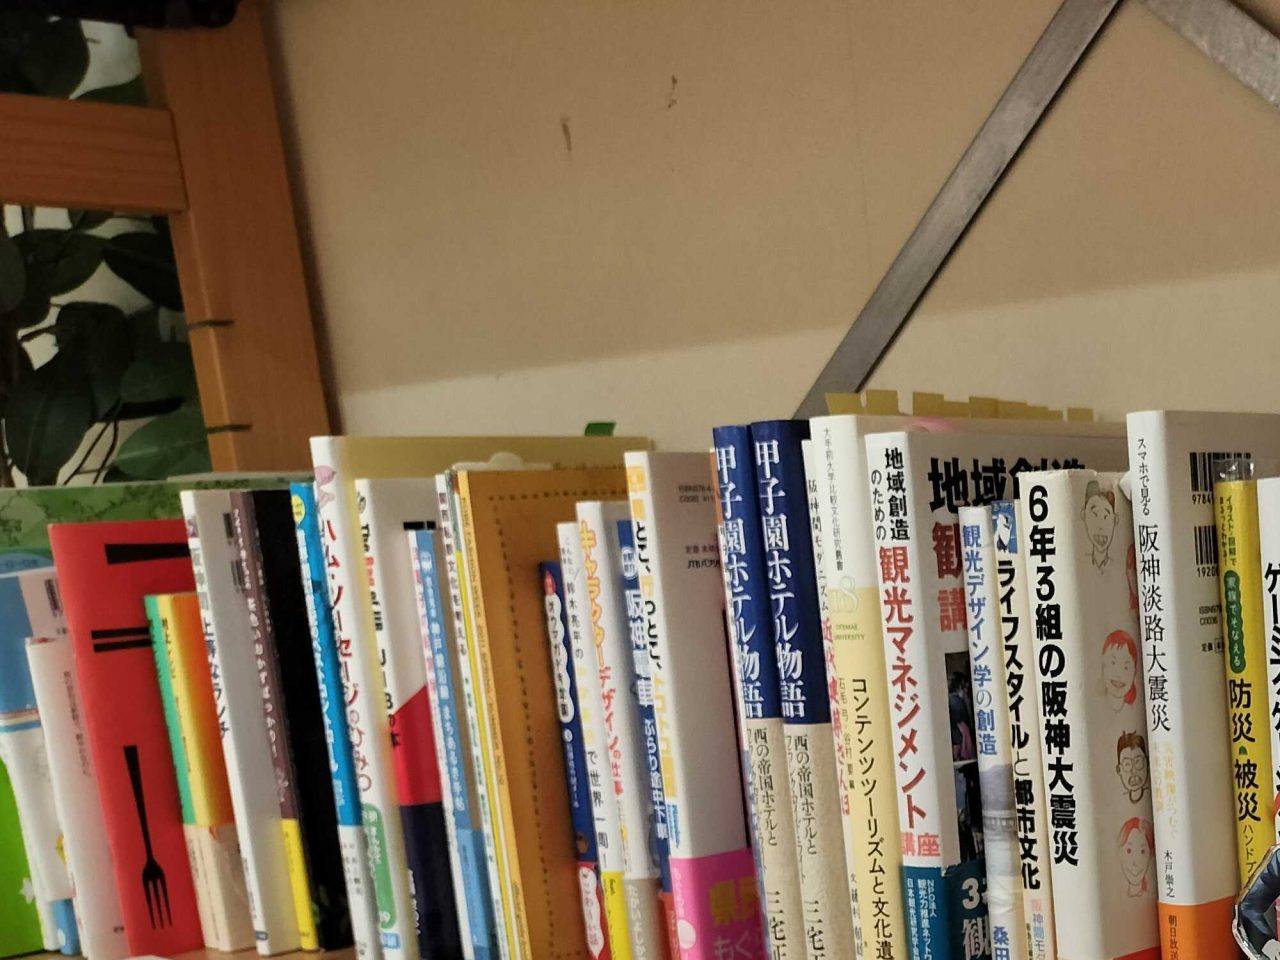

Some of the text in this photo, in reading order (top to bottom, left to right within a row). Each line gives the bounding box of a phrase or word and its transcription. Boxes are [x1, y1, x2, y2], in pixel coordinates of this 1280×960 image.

[361, 523, 371, 552] The
[872, 469, 887, 541] のための
[884, 447, 910, 541] 地域創造
[928, 457, 1085, 514] 地域
[715, 444, 763, 719] 甲子園ホテル物語
[755, 439, 806, 718] 甲子園ホテル物語
[963, 524, 998, 756] 観光デザイン学の創造
[1137, 438, 1172, 732] スマホで見る 阪神淡路大震災
[879, 546, 926, 829] 観光マネジメント
[997, 559, 1041, 890] ライフスタイルと都市文化
[1028, 485, 1079, 866] 6年3組の阪神大震災
[754, 728, 778, 847] 西の帝国ホテルと
[794, 734, 817, 856] 西の帝国ホテルと
[901, 832, 941, 857] 講座
